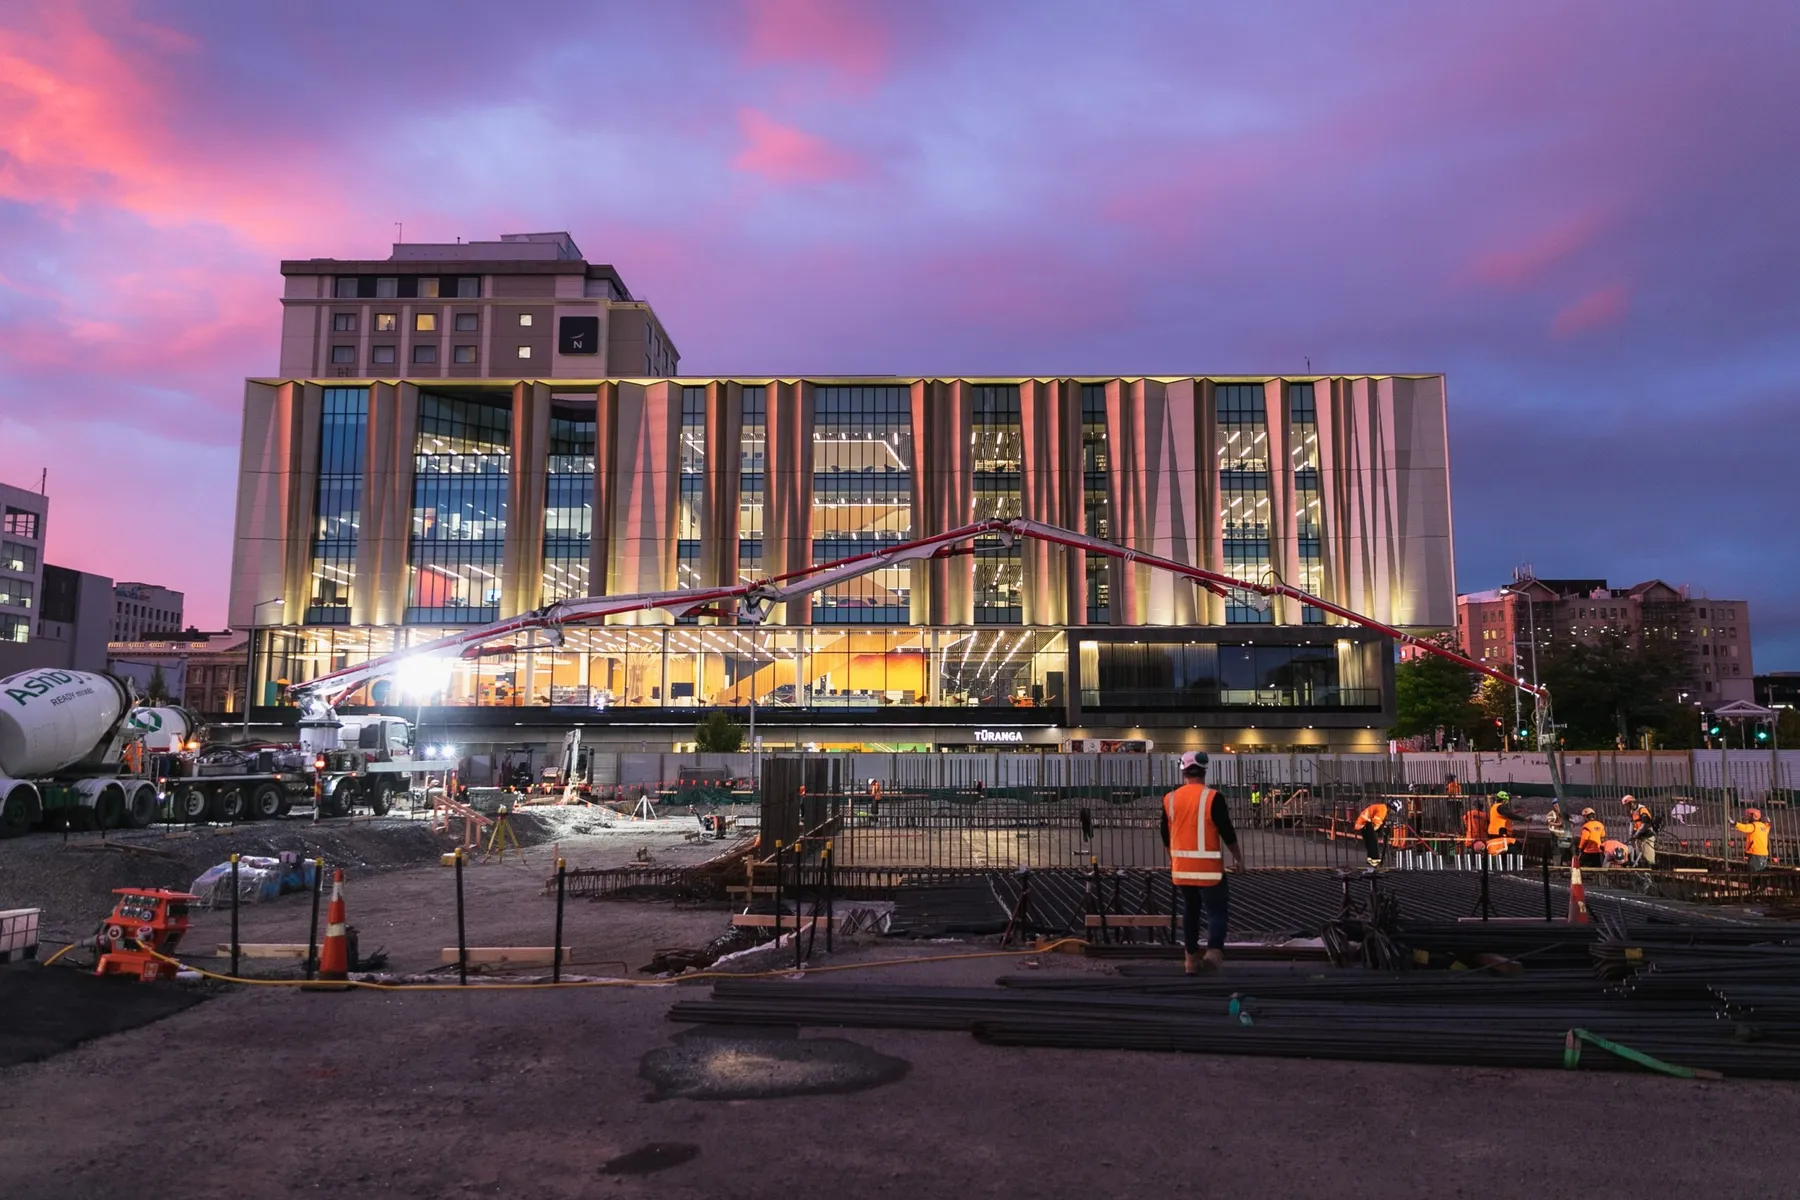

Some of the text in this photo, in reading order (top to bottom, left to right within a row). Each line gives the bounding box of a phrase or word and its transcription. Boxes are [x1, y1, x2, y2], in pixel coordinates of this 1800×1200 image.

[573, 340, 582, 349] N
[50, 691, 76, 706] READY
[974, 729, 1023, 741] TŪRANGA
